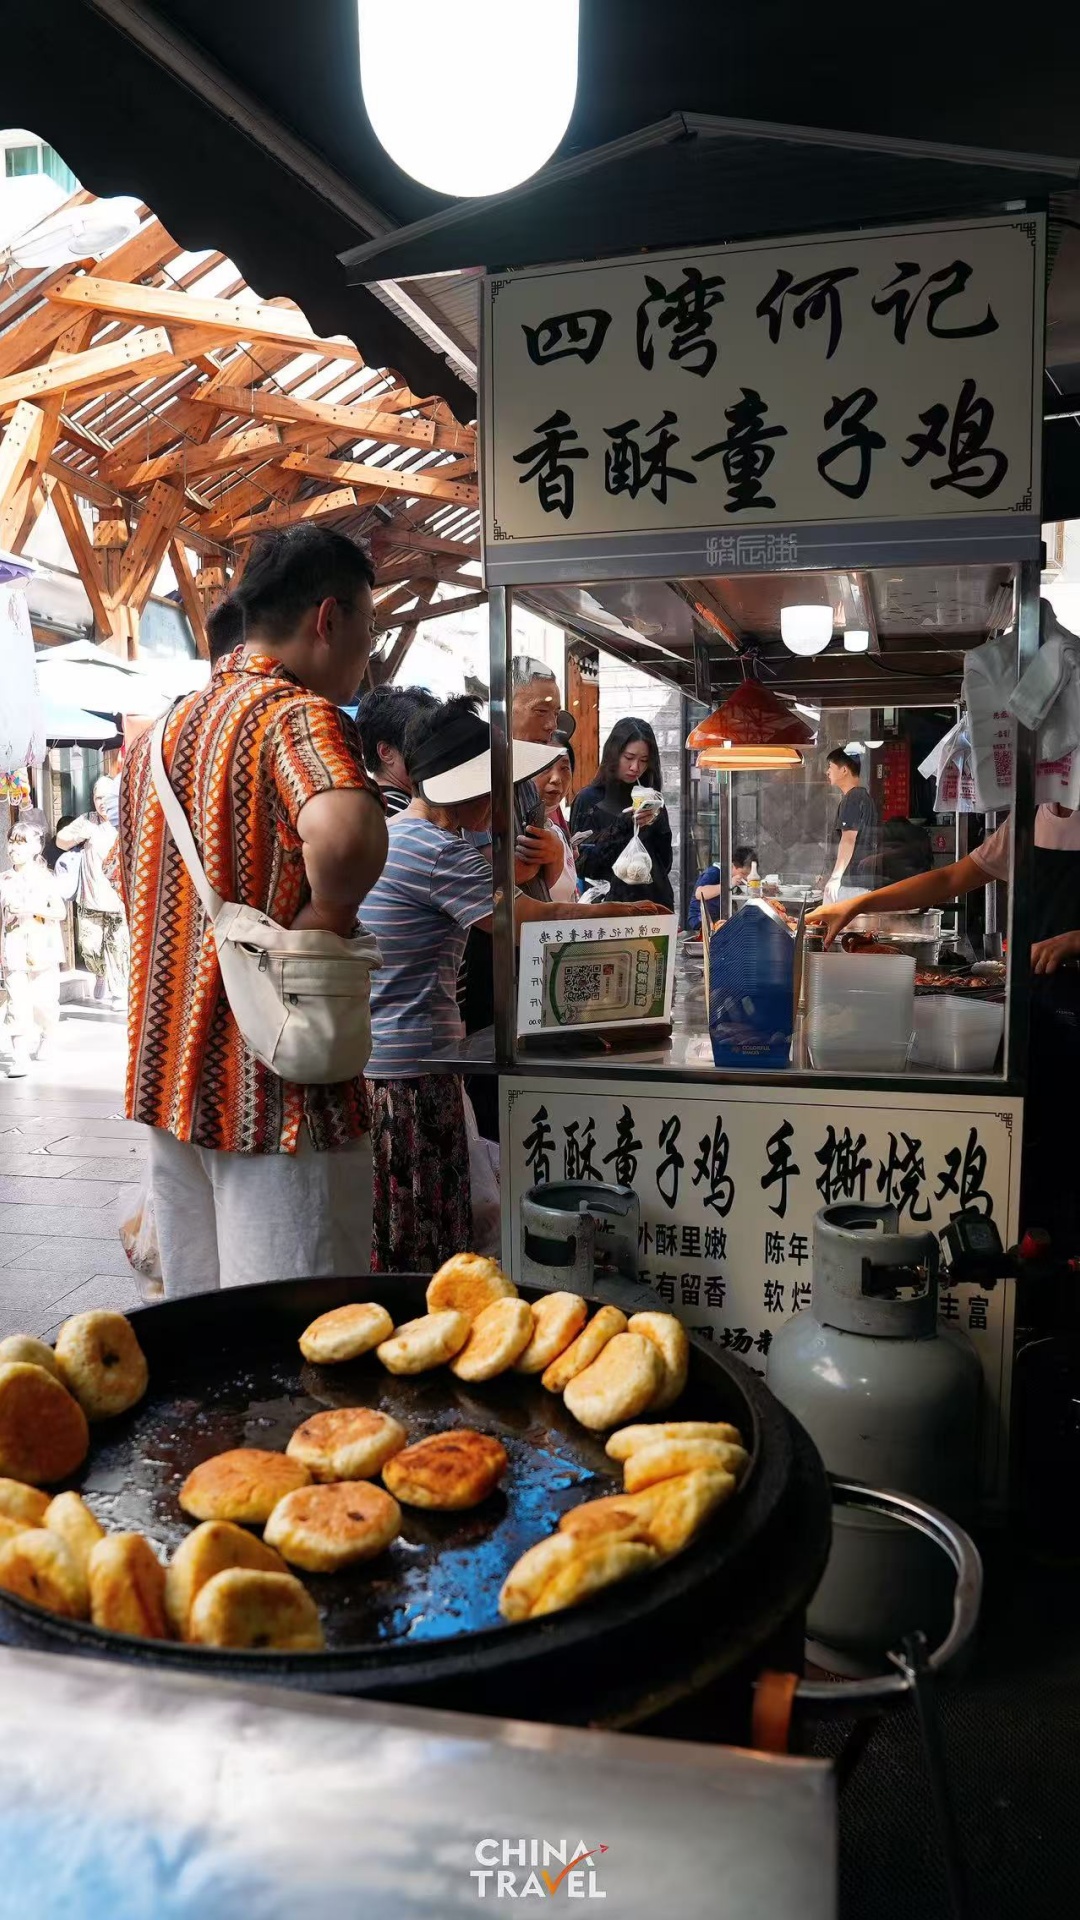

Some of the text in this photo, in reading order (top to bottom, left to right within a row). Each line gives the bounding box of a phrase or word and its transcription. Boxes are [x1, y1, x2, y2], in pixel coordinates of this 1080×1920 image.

[521, 260, 999, 378] 四湾何记
[512, 379, 1010, 520] 香酥童子鸡
[522, 1103, 735, 1218] 香酥童子鸡
